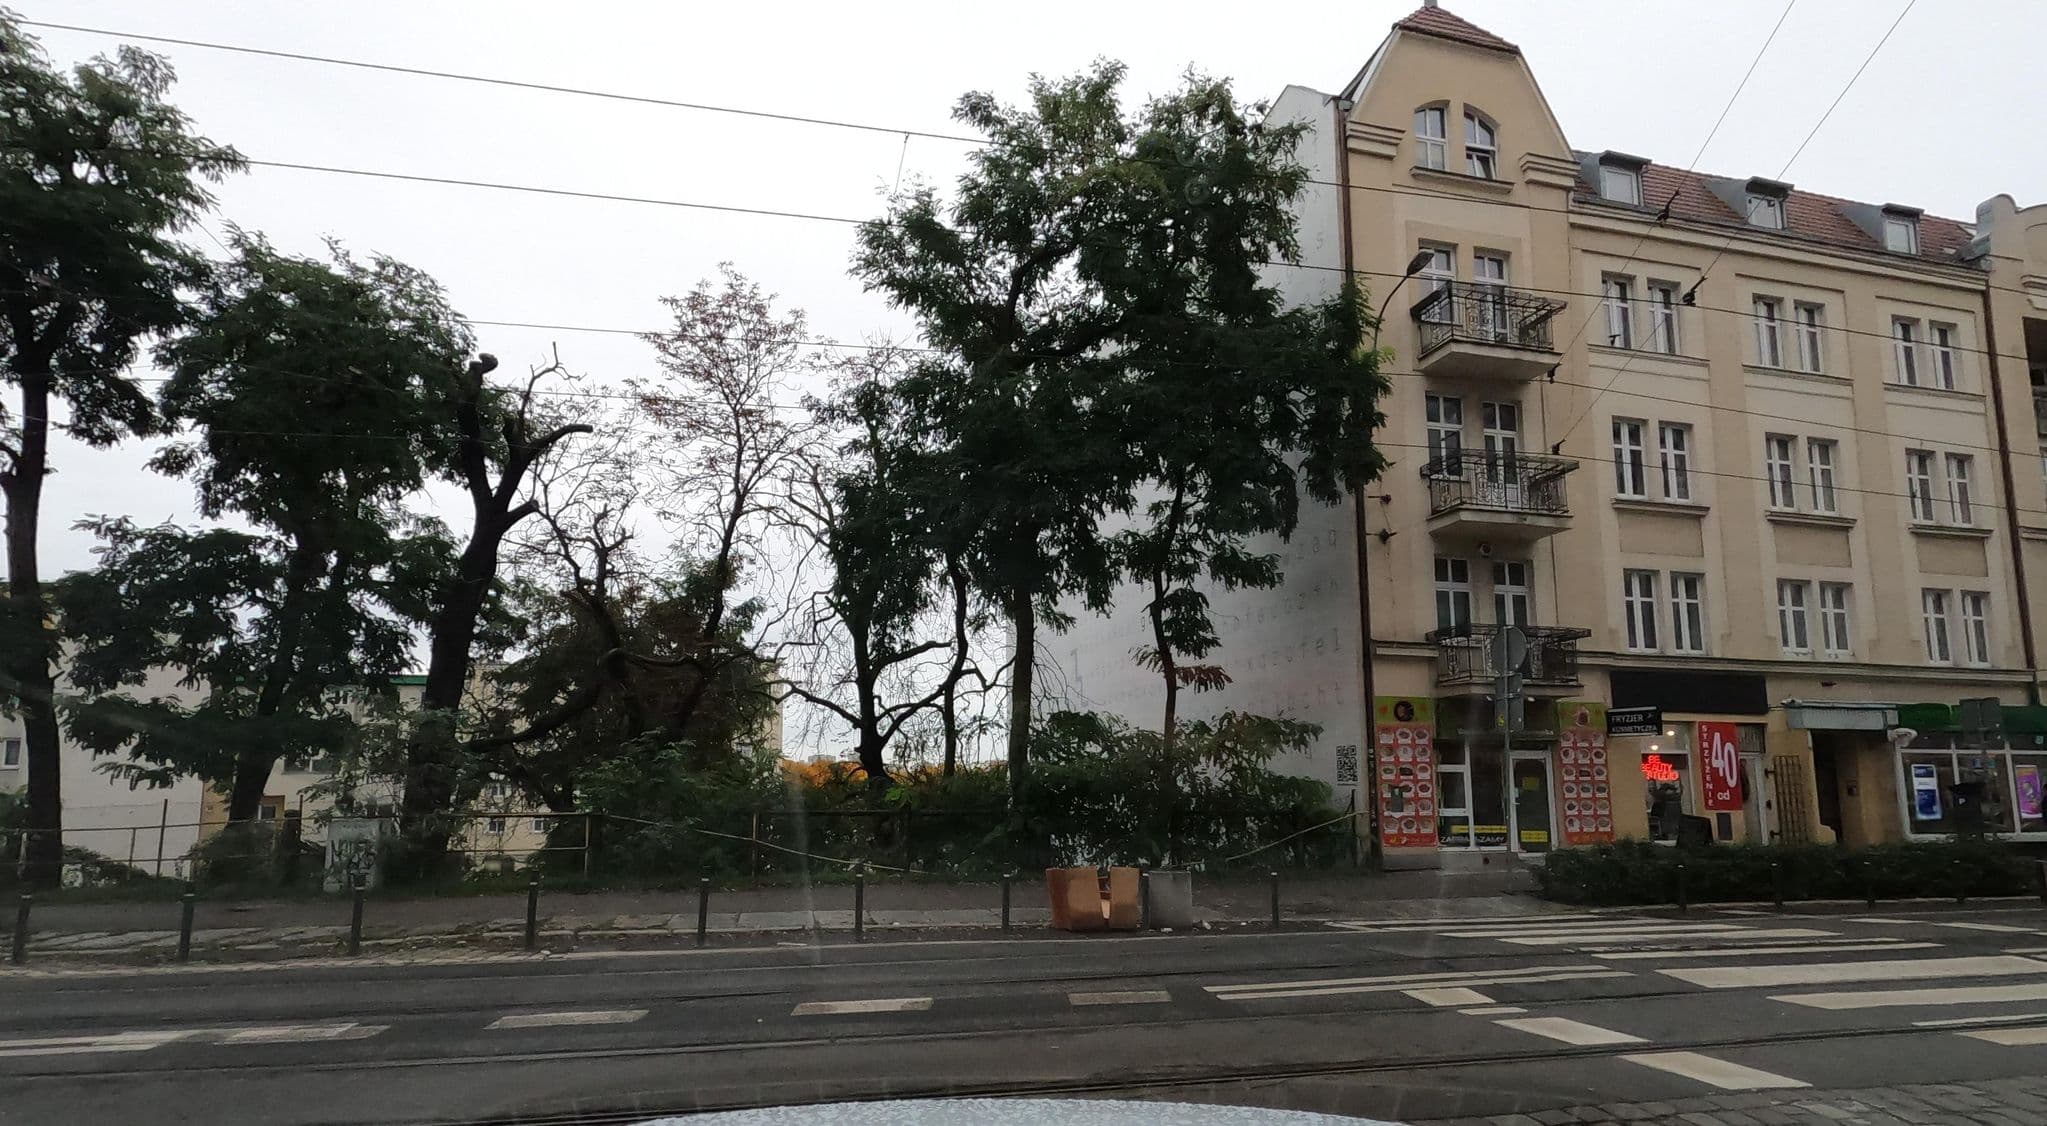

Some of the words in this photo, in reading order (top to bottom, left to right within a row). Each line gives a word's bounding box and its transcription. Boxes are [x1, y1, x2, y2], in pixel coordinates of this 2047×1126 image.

[1612, 714, 1644, 722] FRYZJER
[1647, 755, 1661, 764] BE
[1711, 731, 1738, 788] 40
[1641, 763, 1673, 773] BEAUTY
[1646, 771, 1679, 781] STUDIO
[1717, 789, 1730, 801] od
